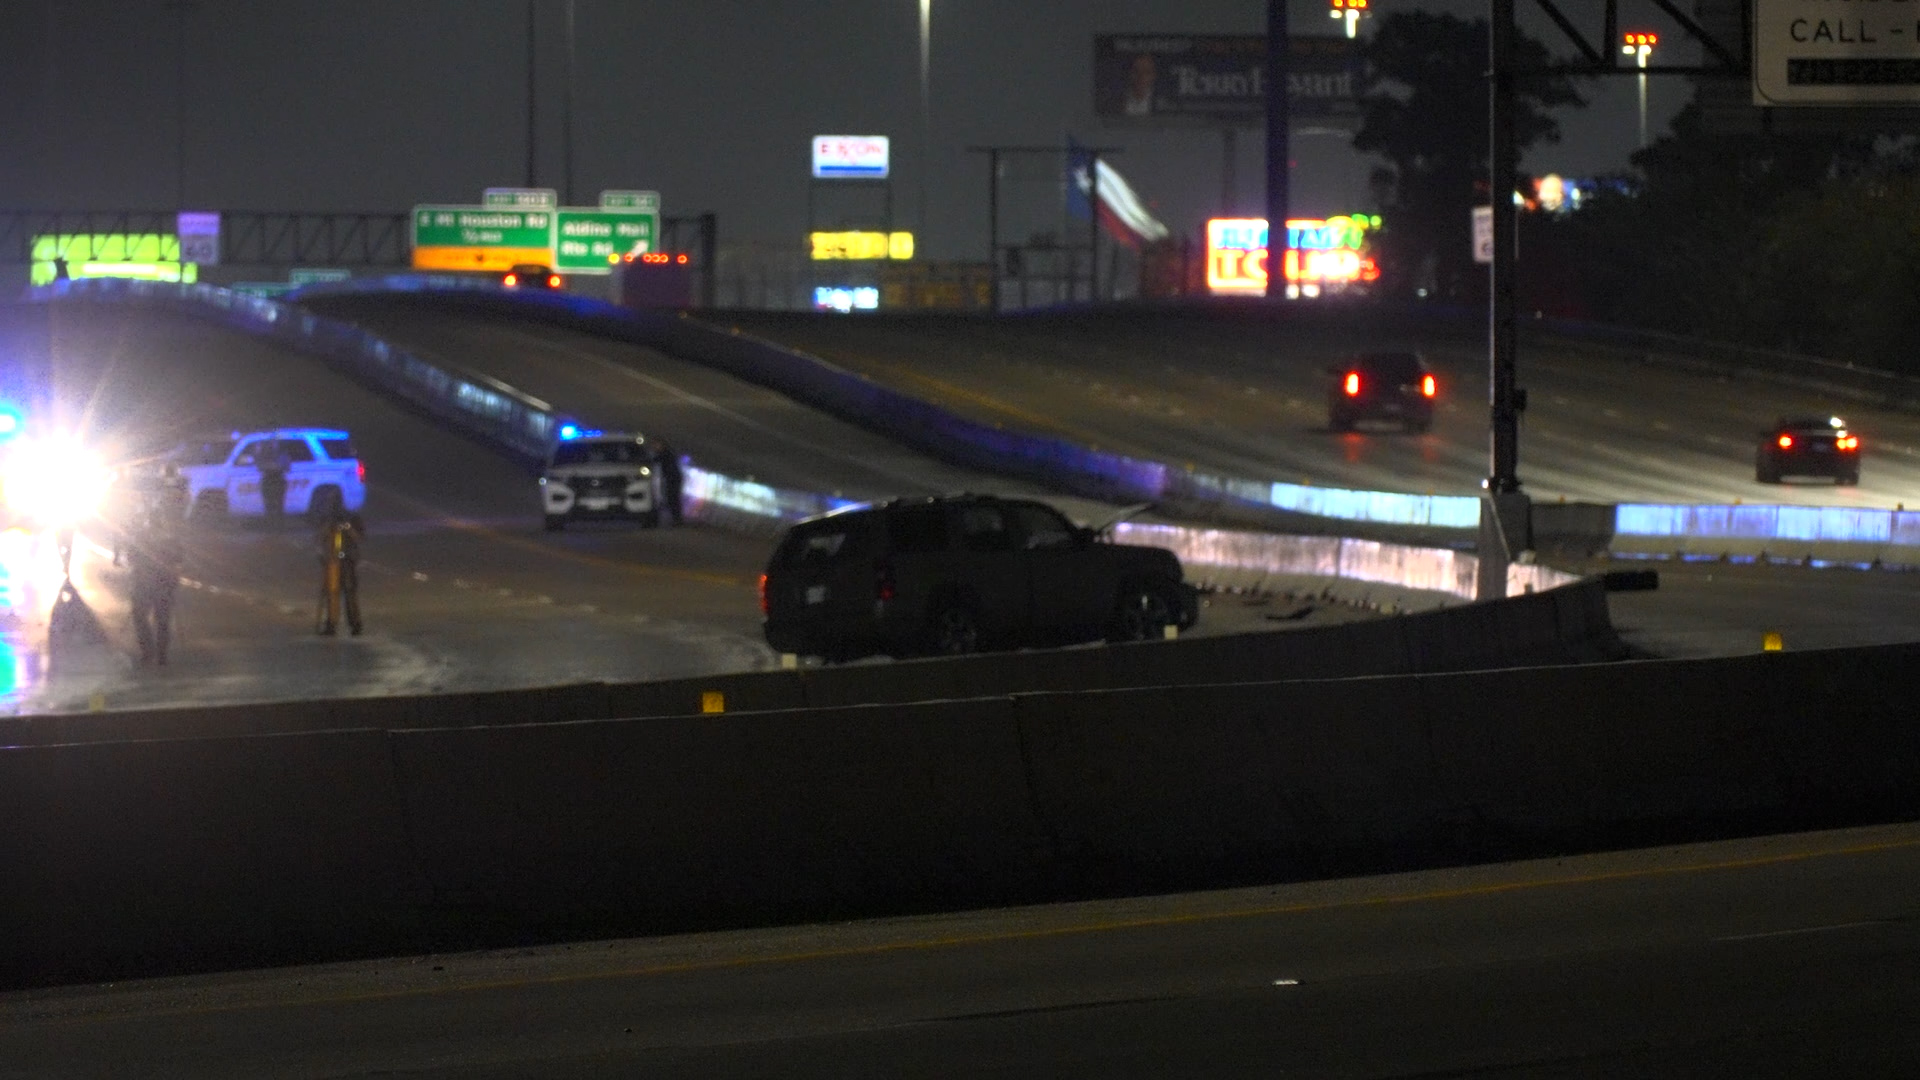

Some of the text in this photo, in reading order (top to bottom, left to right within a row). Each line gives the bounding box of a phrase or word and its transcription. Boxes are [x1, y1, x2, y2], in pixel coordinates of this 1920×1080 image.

[1790, 17, 1878, 43] CALL
[459, 213, 522, 229] Houston
[525, 214, 547, 229] Rd
[562, 220, 612, 236] Aldine
[591, 241, 613, 256] Rd
